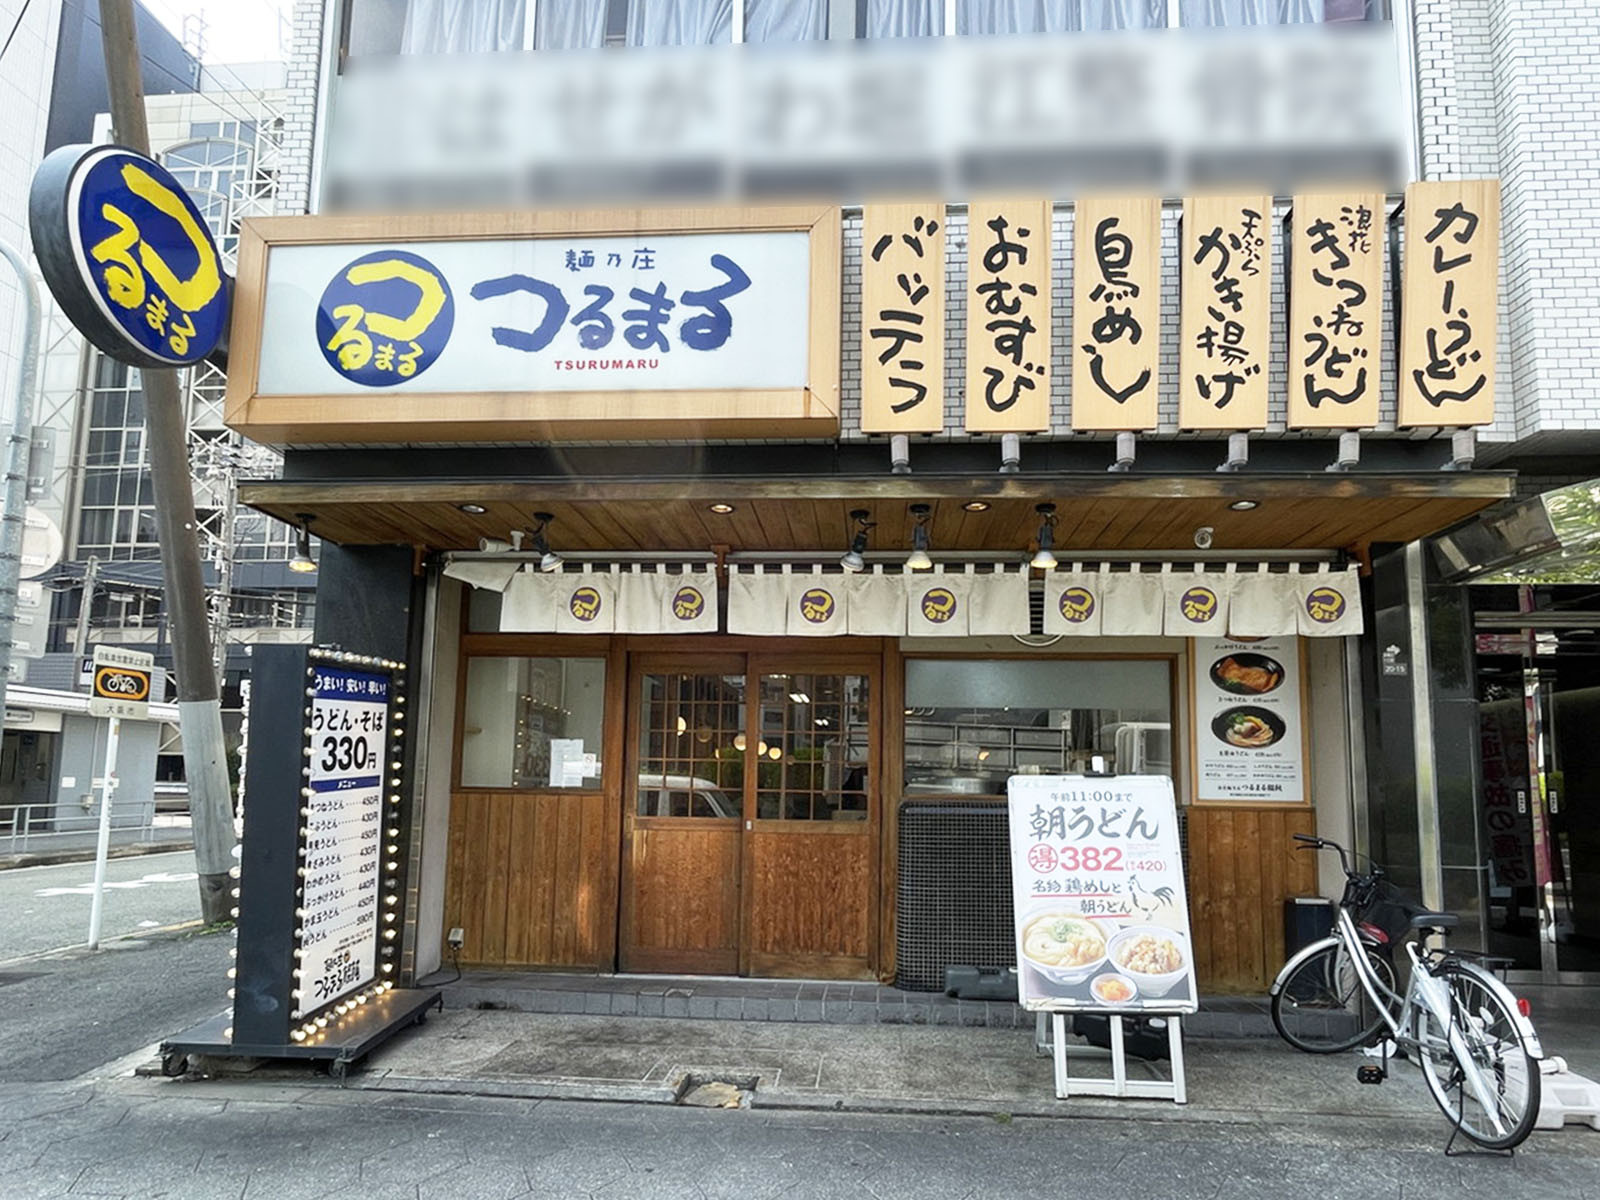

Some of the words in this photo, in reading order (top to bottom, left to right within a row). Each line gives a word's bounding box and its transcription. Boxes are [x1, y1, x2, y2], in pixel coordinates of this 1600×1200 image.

[90, 163, 221, 356] つるまる
[1241, 209, 1264, 276] 天ぷら
[1340, 205, 1372, 254] 浪花
[327, 259, 447, 377] つるまる
[469, 254, 752, 352] つるまる
[870, 216, 938, 413] バッテラ
[976, 216, 1045, 412] おむすび
[1082, 217, 1151, 404] 鳥めし
[1194, 227, 1260, 408] かき揚げ
[1304, 219, 1368, 408] きつねうどん
[1413, 202, 1486, 407] カレーうどん
[555, 359, 659, 370] TSURUMARU
[313, 708, 384, 732] うどん・そば
[322, 736, 377, 772] 330円
[1029, 804, 1159, 841] 朝うどん
[1060, 847, 1124, 871] 382
[1080, 899, 1132, 914] 朝うどん
